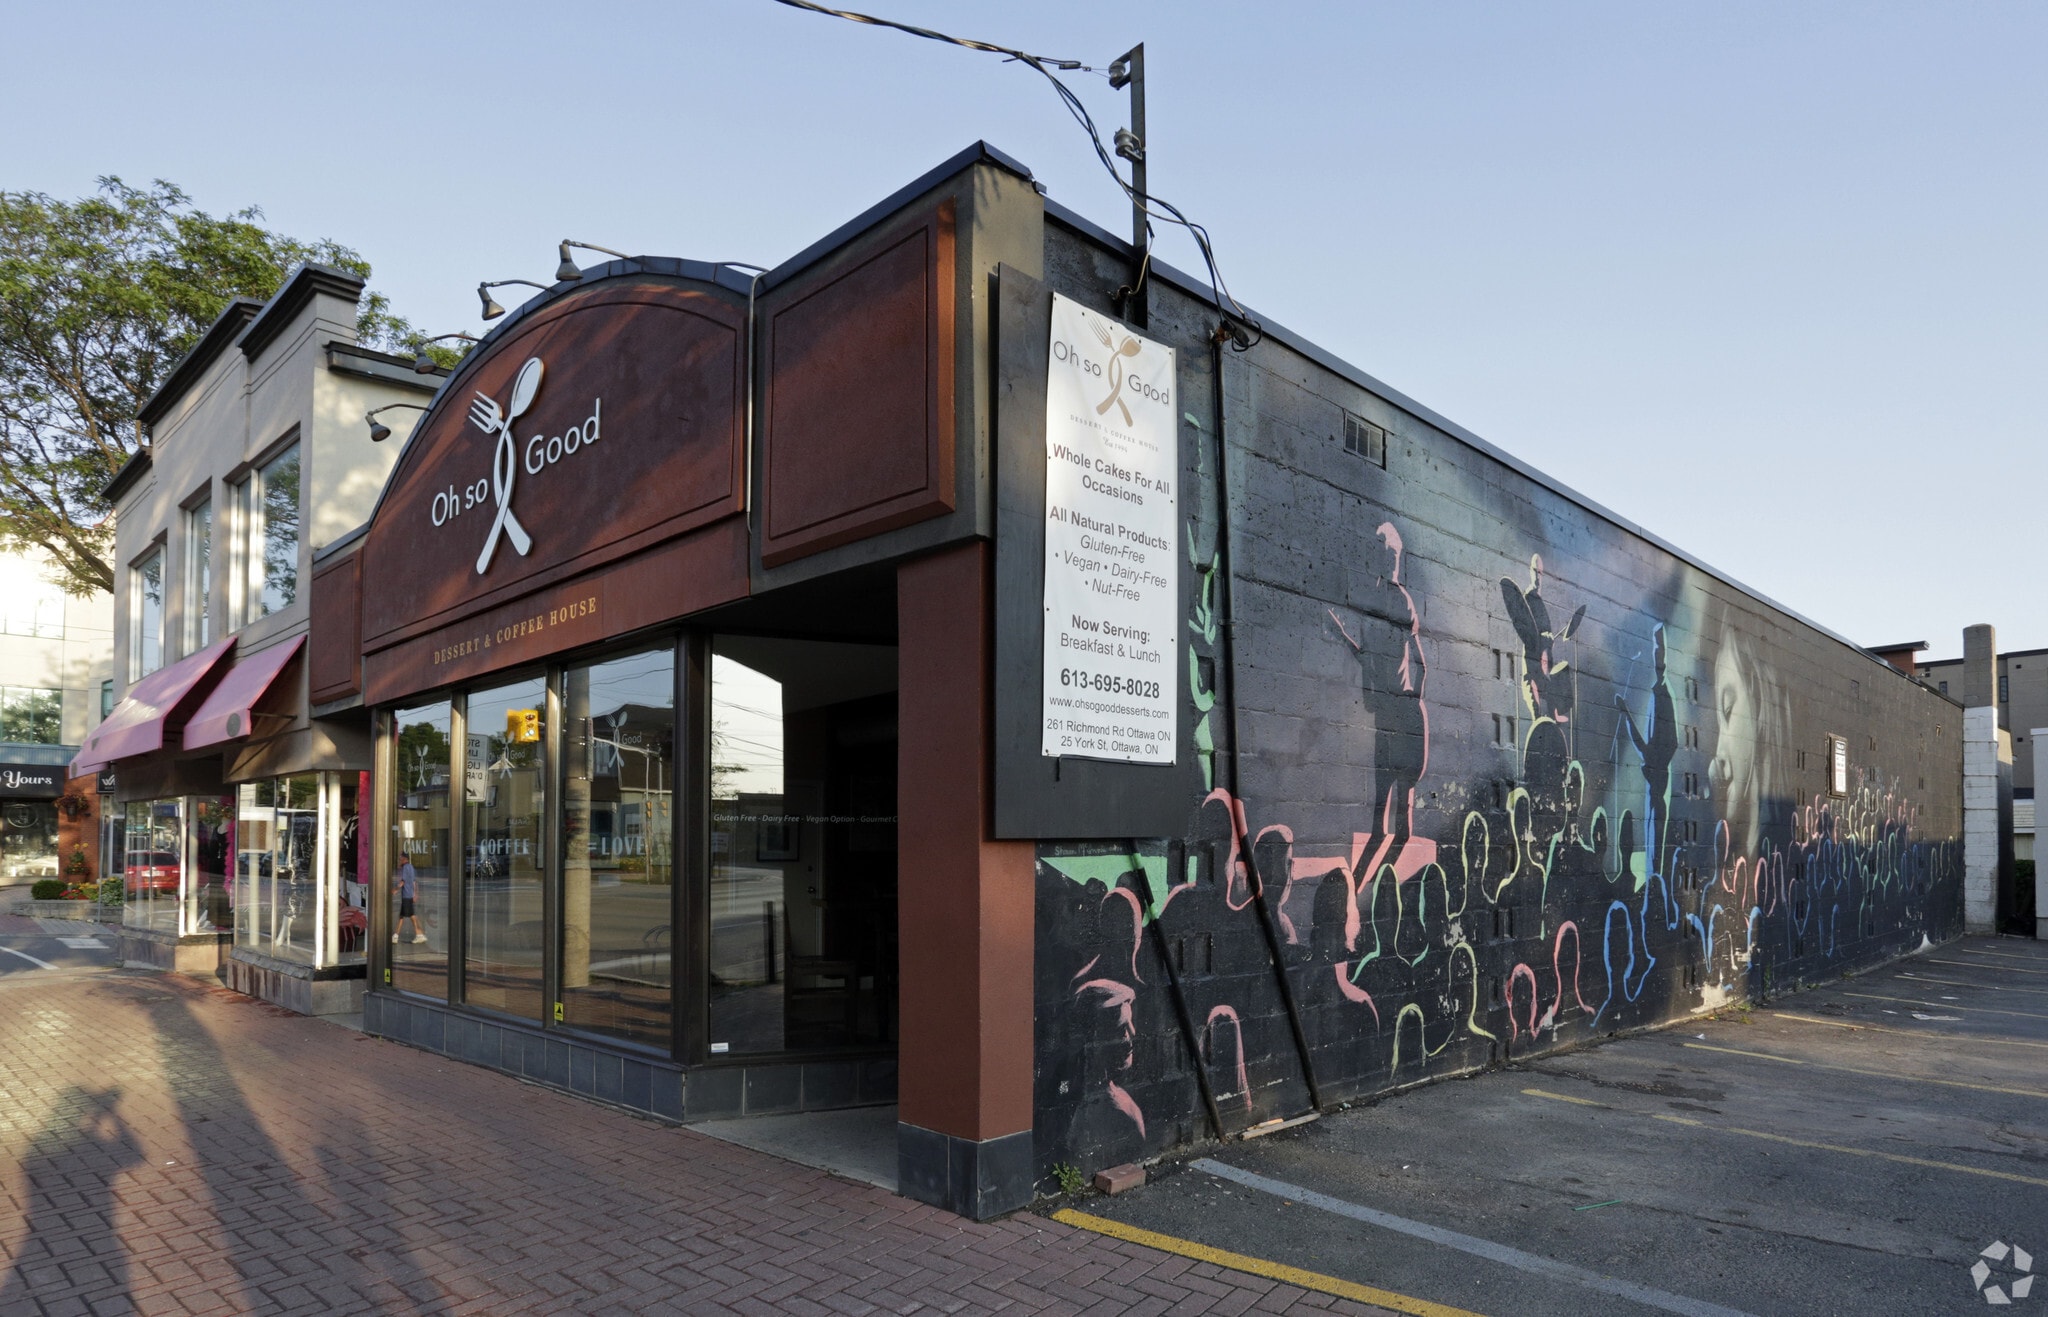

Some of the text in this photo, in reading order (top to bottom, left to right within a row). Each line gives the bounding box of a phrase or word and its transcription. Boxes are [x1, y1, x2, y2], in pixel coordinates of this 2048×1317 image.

[1053, 340, 1102, 377] Oh so
[1128, 374, 1170, 405] Good
[525, 397, 602, 475] Good
[1053, 443, 1170, 495] Whole Cakes For All
[431, 478, 488, 527] Oh so
[1082, 474, 1144, 506] Occasions
[1049, 506, 1171, 552] All Natural Products:
[1080, 534, 1146, 564] Gluten-Free
[1064, 550, 1167, 588] Vegan Dairy-Free
[1091, 578, 1140, 601] Nut-Free
[434, 596, 597, 665] DESSERT & COFFEE HOUSE
[1072, 614, 1151, 645] Now Serving:
[1060, 632, 1161, 663] Breakfast & Lunch
[1060, 668, 1160, 699] 613-695-8028
[1049, 696, 1169, 719] www.ohsogooddesserts.com
[621, 731, 642, 746] Good
[1047, 718, 1171, 742] 261 Richmond Rd Ottawa ON
[1061, 736, 1159, 754] 25 York St, Ottawa, ON
[3, 770, 53, 789] Yours
[713, 813, 739, 822] Gluten
[740, 814, 757, 822] Free
[762, 814, 783, 824] Dairy
[784, 814, 800, 823] Free
[806, 815, 829, 824] Vegan
[830, 816, 855, 824] Option
[403, 839, 429, 855] CAKE
[480, 838, 530, 856] COFFEE
[601, 836, 647, 856] LOVE
